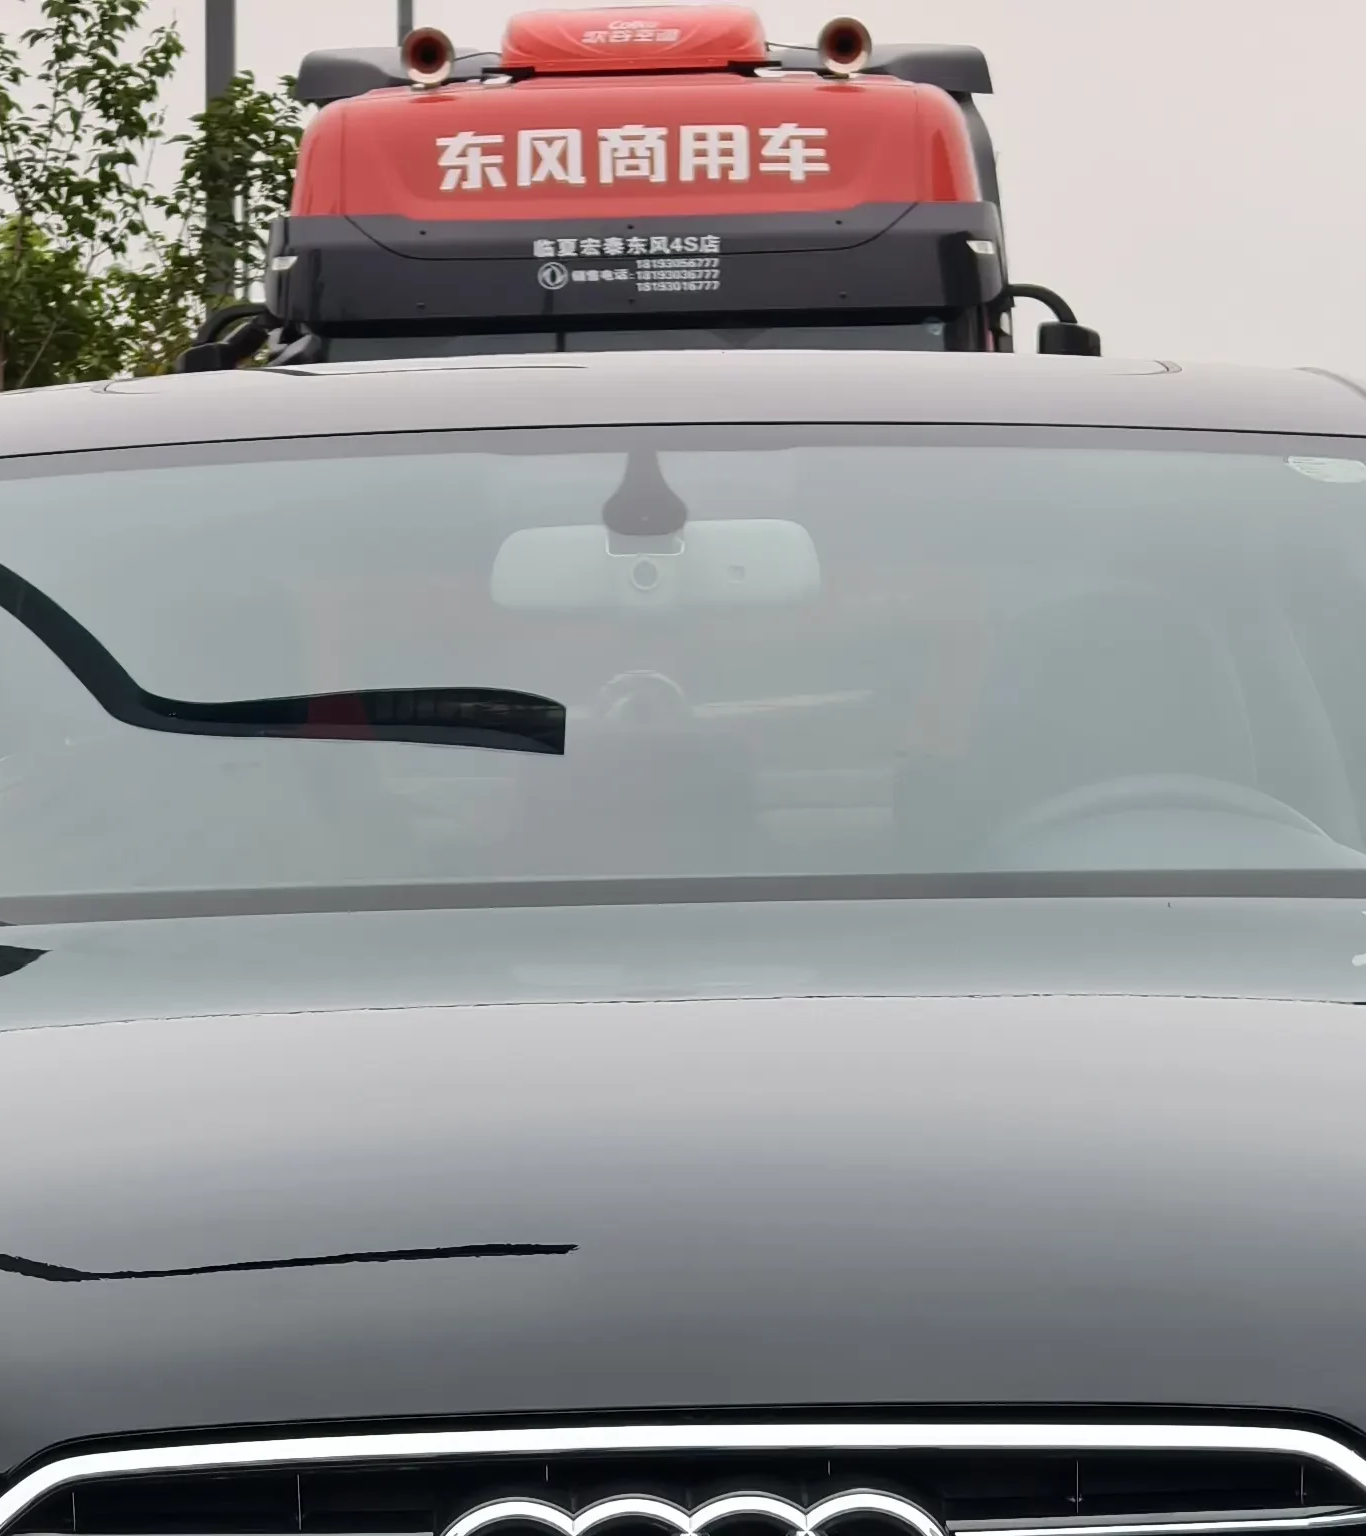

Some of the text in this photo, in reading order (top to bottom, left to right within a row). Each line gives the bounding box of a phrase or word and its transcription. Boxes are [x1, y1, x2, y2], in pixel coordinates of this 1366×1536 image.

[436, 123, 830, 190] 东风商用车
[533, 235, 720, 257] 临夏宏泰东风4S店
